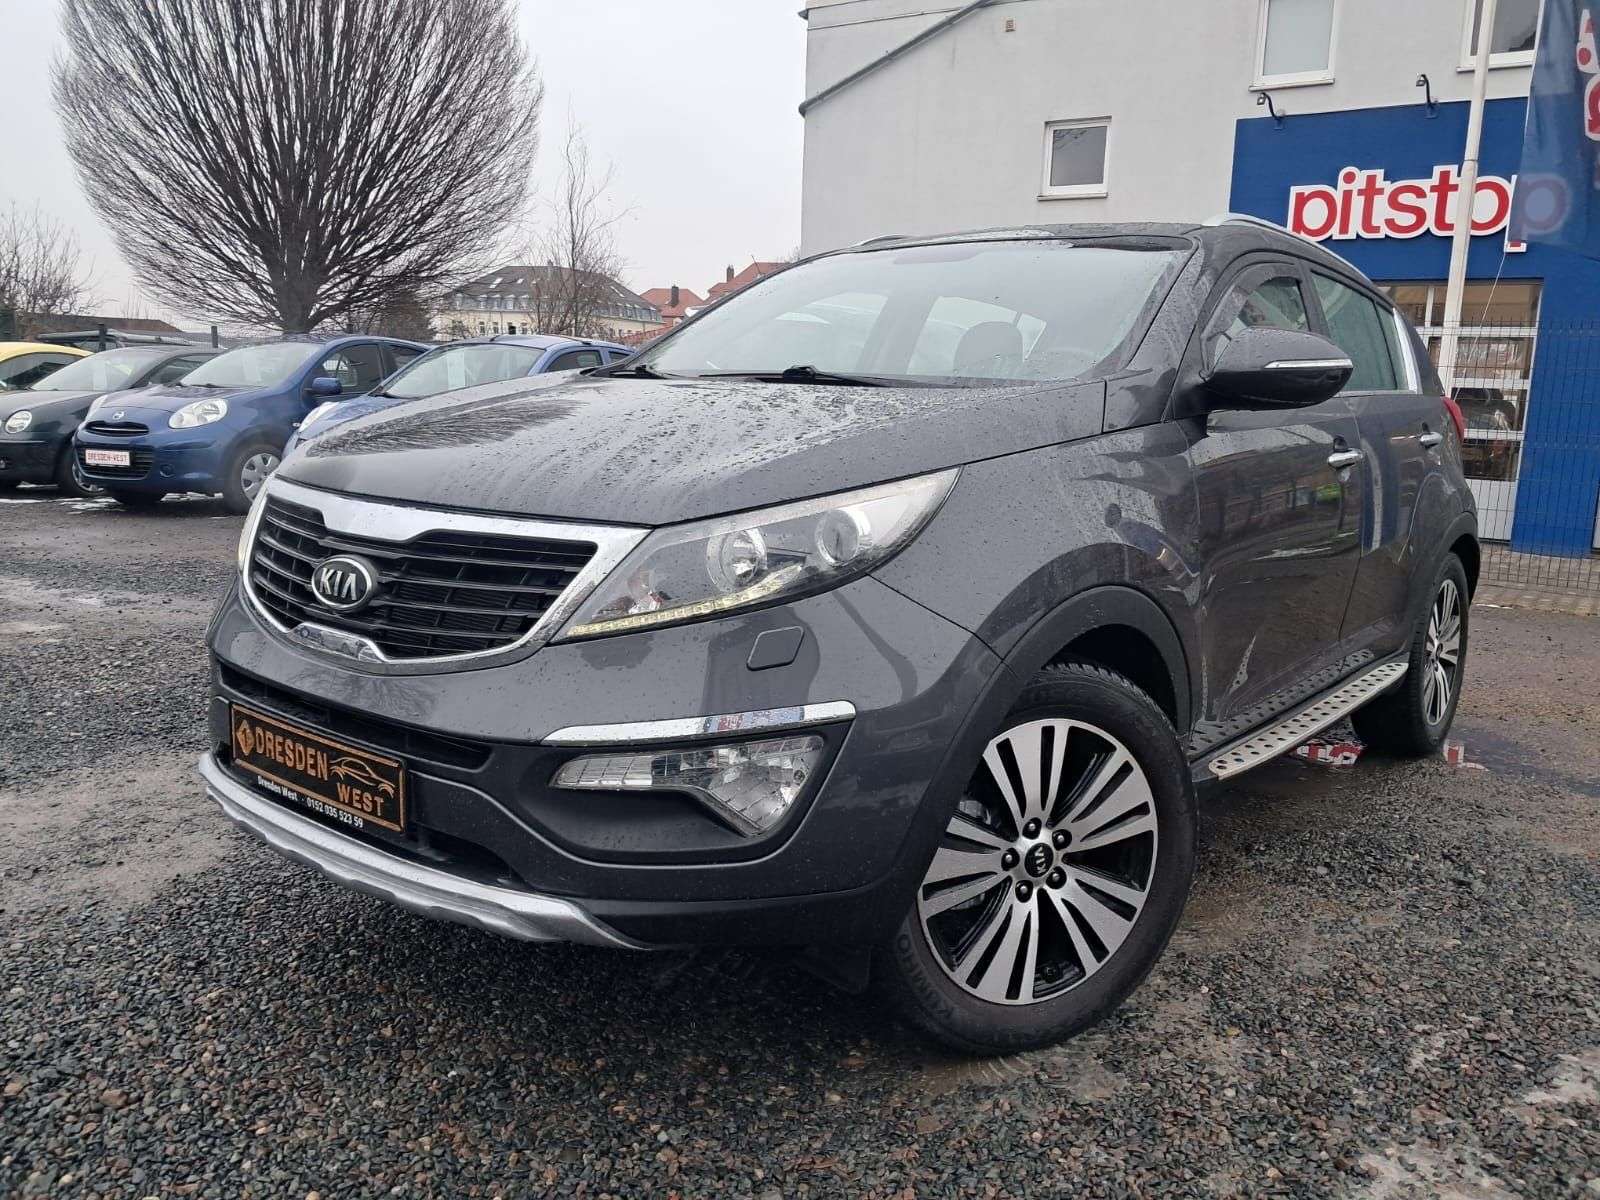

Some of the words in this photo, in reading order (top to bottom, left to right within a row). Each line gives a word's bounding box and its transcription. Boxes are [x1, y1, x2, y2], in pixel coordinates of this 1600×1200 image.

[1288, 164, 1572, 250] pitstop
[319, 567, 357, 601] KIA
[255, 726, 328, 781] DRESDEN
[306, 797, 324, 813] 0152
[353, 816, 363, 828] 59
[337, 782, 384, 816] WEST
